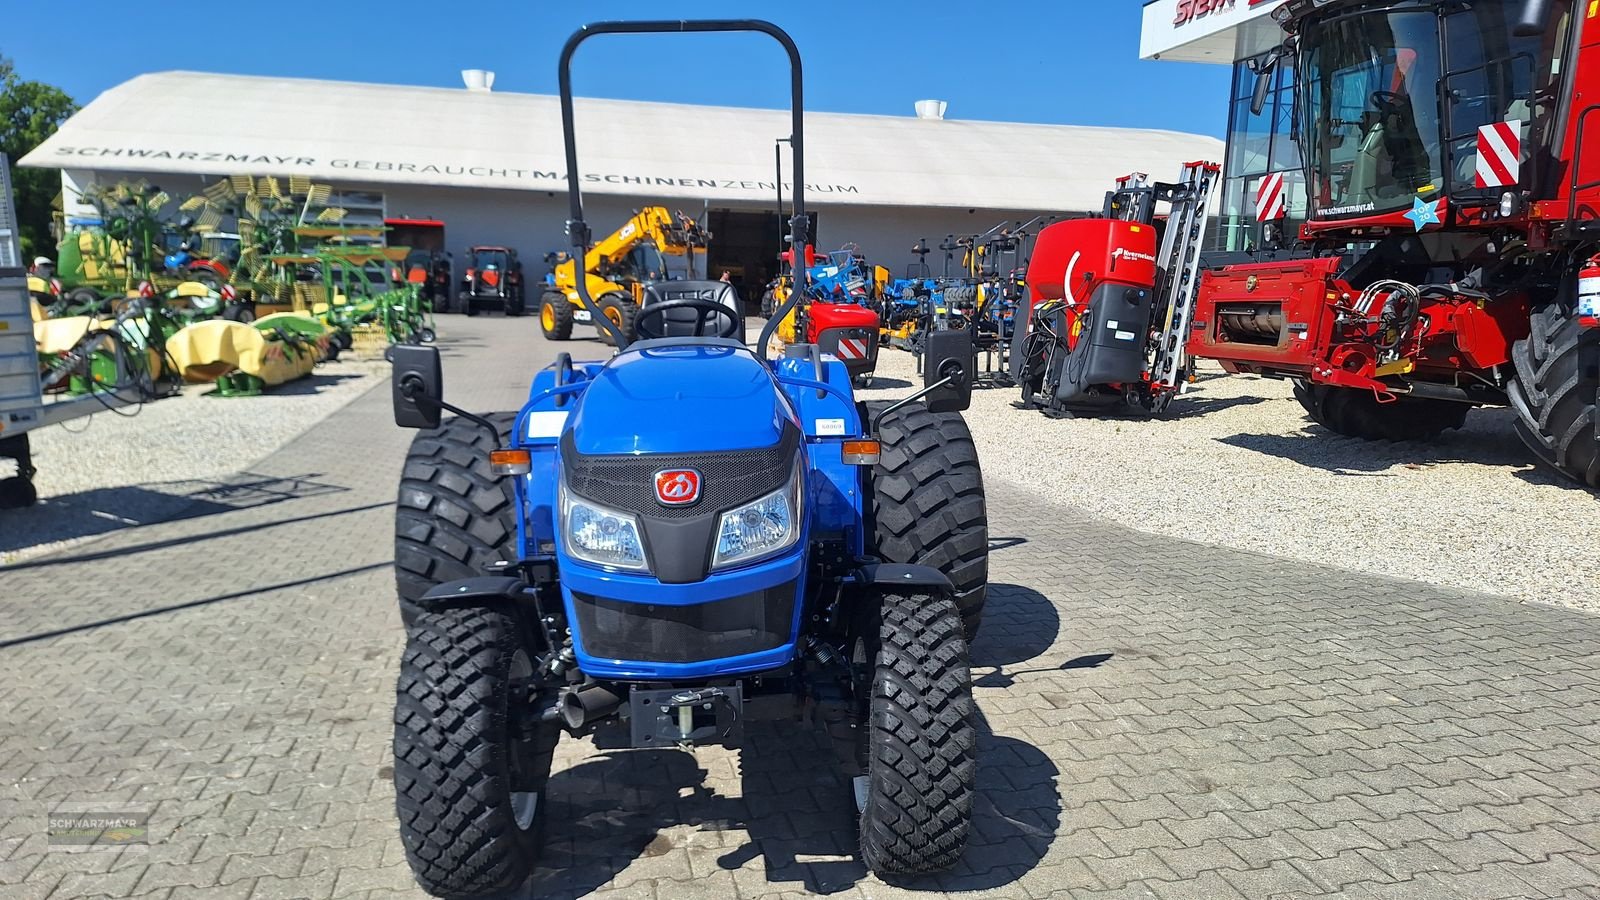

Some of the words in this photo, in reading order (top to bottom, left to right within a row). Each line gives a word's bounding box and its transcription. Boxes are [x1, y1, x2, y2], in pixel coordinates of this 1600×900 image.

[56, 147, 316, 166] SCHWARZMAYR
[1316, 201, 1375, 216] www.schwarzmayr.at
[1414, 204, 1431, 215] TOP
[1418, 212, 1431, 222] 20
